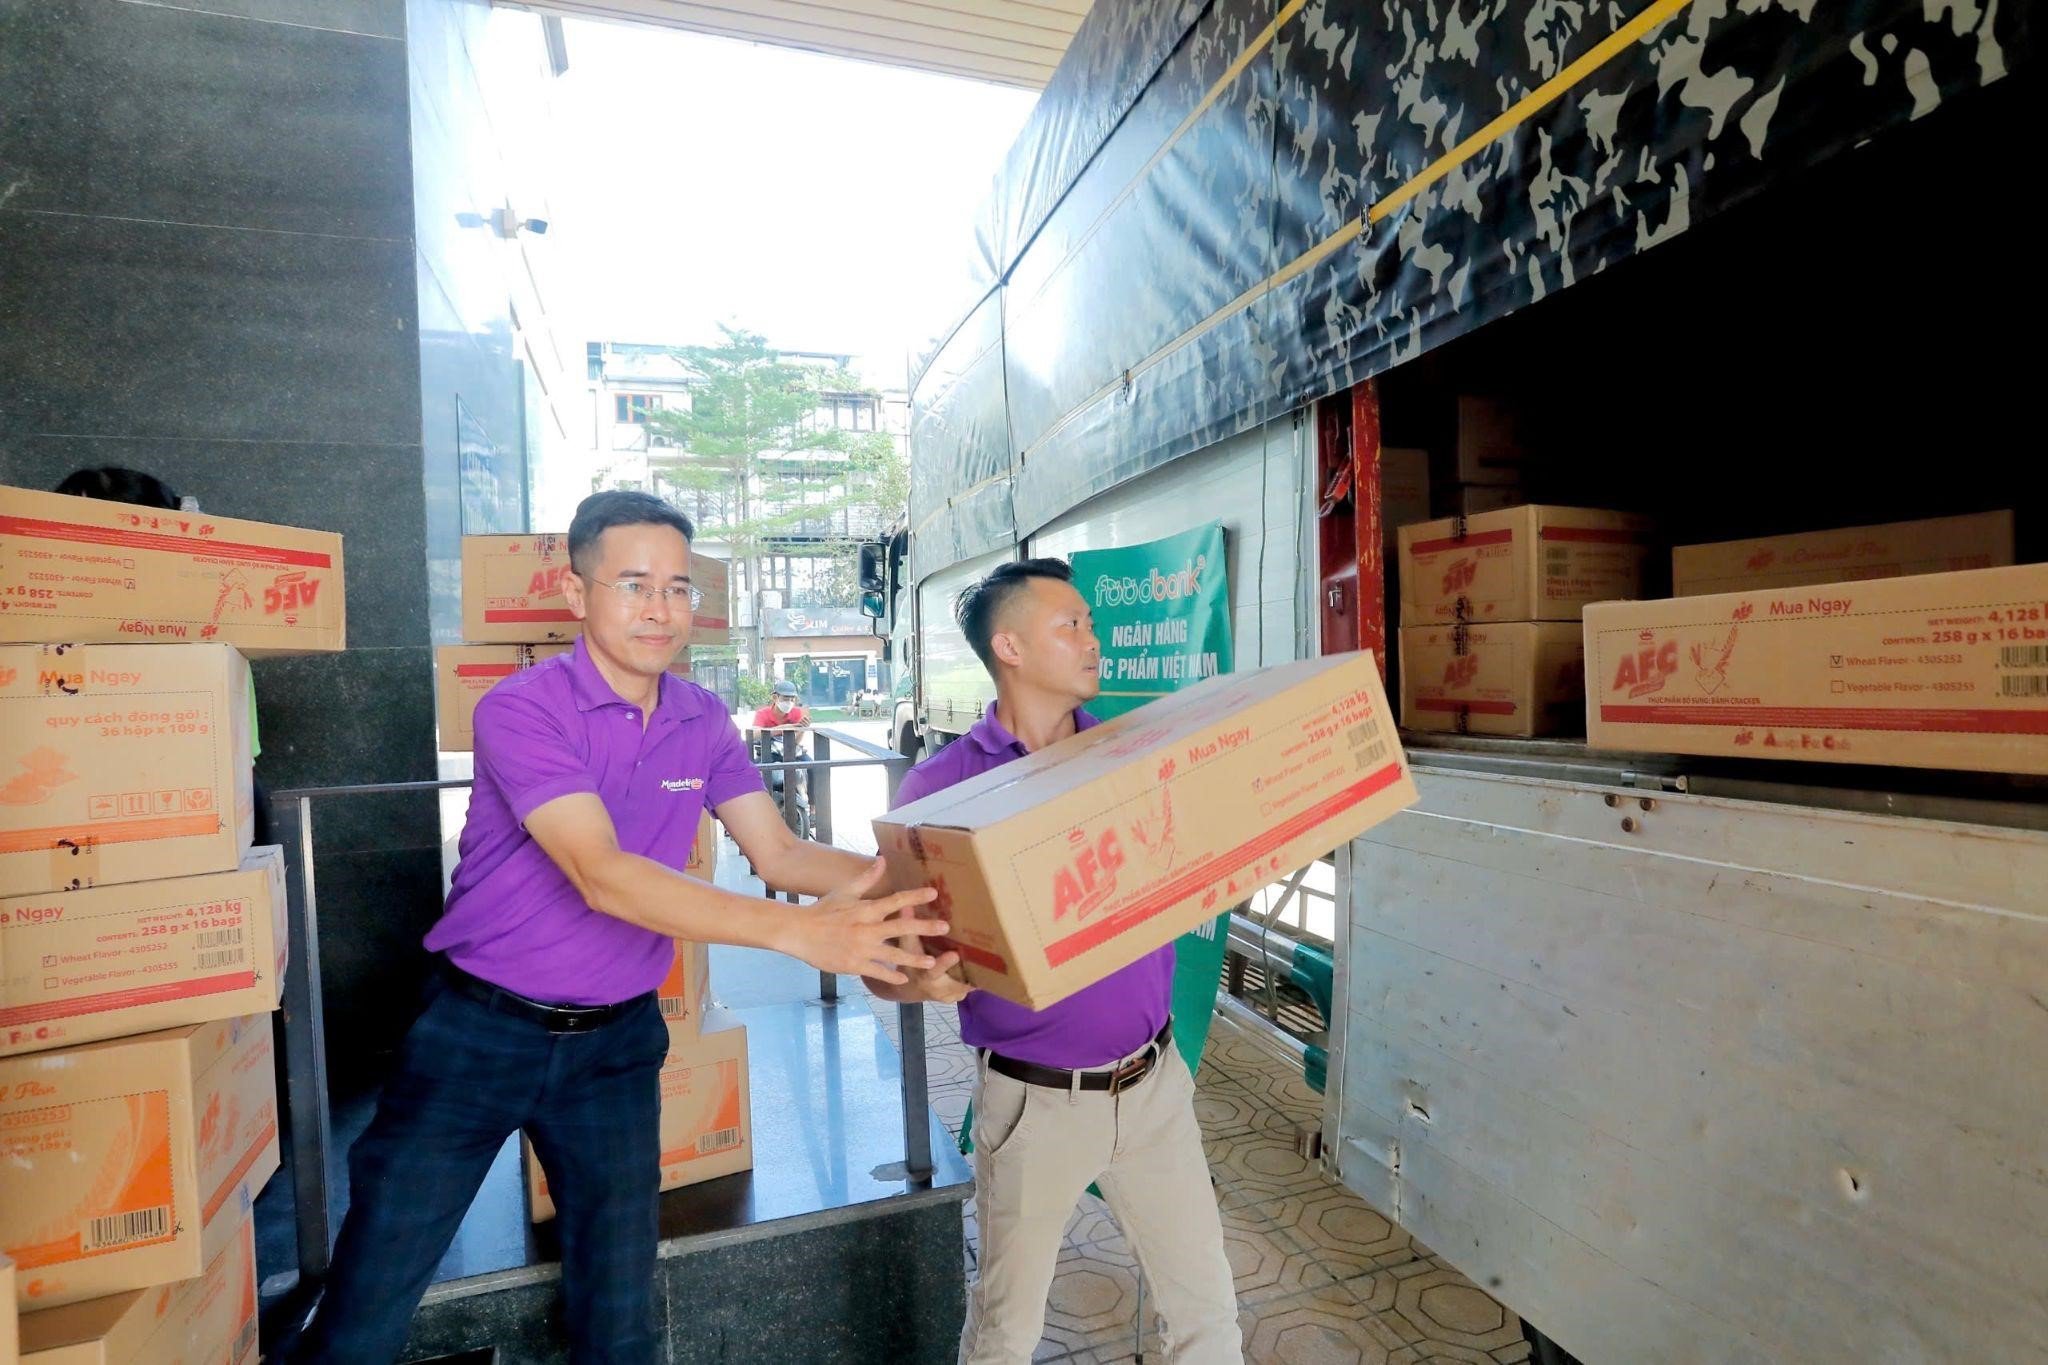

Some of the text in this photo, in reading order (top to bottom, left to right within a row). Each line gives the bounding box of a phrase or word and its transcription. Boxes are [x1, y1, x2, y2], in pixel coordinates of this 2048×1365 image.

[18, 585, 26, 596] g
[29, 588, 54, 599] 258
[1769, 601, 1805, 616] Mua
[1808, 599, 1852, 615] Ngay
[1988, 608, 2040, 624] 4,128
[118, 620, 155, 636] Ngay
[158, 625, 187, 638] Mua
[1111, 617, 1188, 648] NGÂN HÀNG
[1932, 630, 1963, 643] 258
[1967, 632, 1978, 645] g
[1982, 631, 1992, 641] x
[1997, 628, 2019, 641] 16
[2023, 626, 2048, 640] ba
[1117, 648, 1159, 681] PHẨM
[1162, 652, 1187, 684] VIỆT
[1188, 651, 1219, 679] NAM
[1612, 640, 1679, 692] AFC
[38, 669, 142, 687] Mua Ngay
[1356, 688, 1369, 705] kg
[46, 713, 80, 729] quy
[100, 726, 120, 738] 36
[199, 723, 210, 736] g
[1188, 742, 1217, 764] Mua
[1217, 726, 1251, 749] Ngay
[1052, 825, 1125, 924] AFC
[15, 905, 64, 925] Ngay
[185, 904, 222, 918] 4,128
[224, 900, 242, 915] kg
[141, 924, 167, 937] 258
[170, 926, 178, 936] g
[182, 922, 190, 931] x
[194, 919, 209, 930] 16
[211, 914, 243, 929] bags
[60, 952, 92, 966] Wheat
[93, 948, 122, 962] Flavor
[61, 971, 107, 988] Vegetable
[108, 968, 136, 980] Flavor
[4, 1109, 66, 1127] 4305253
